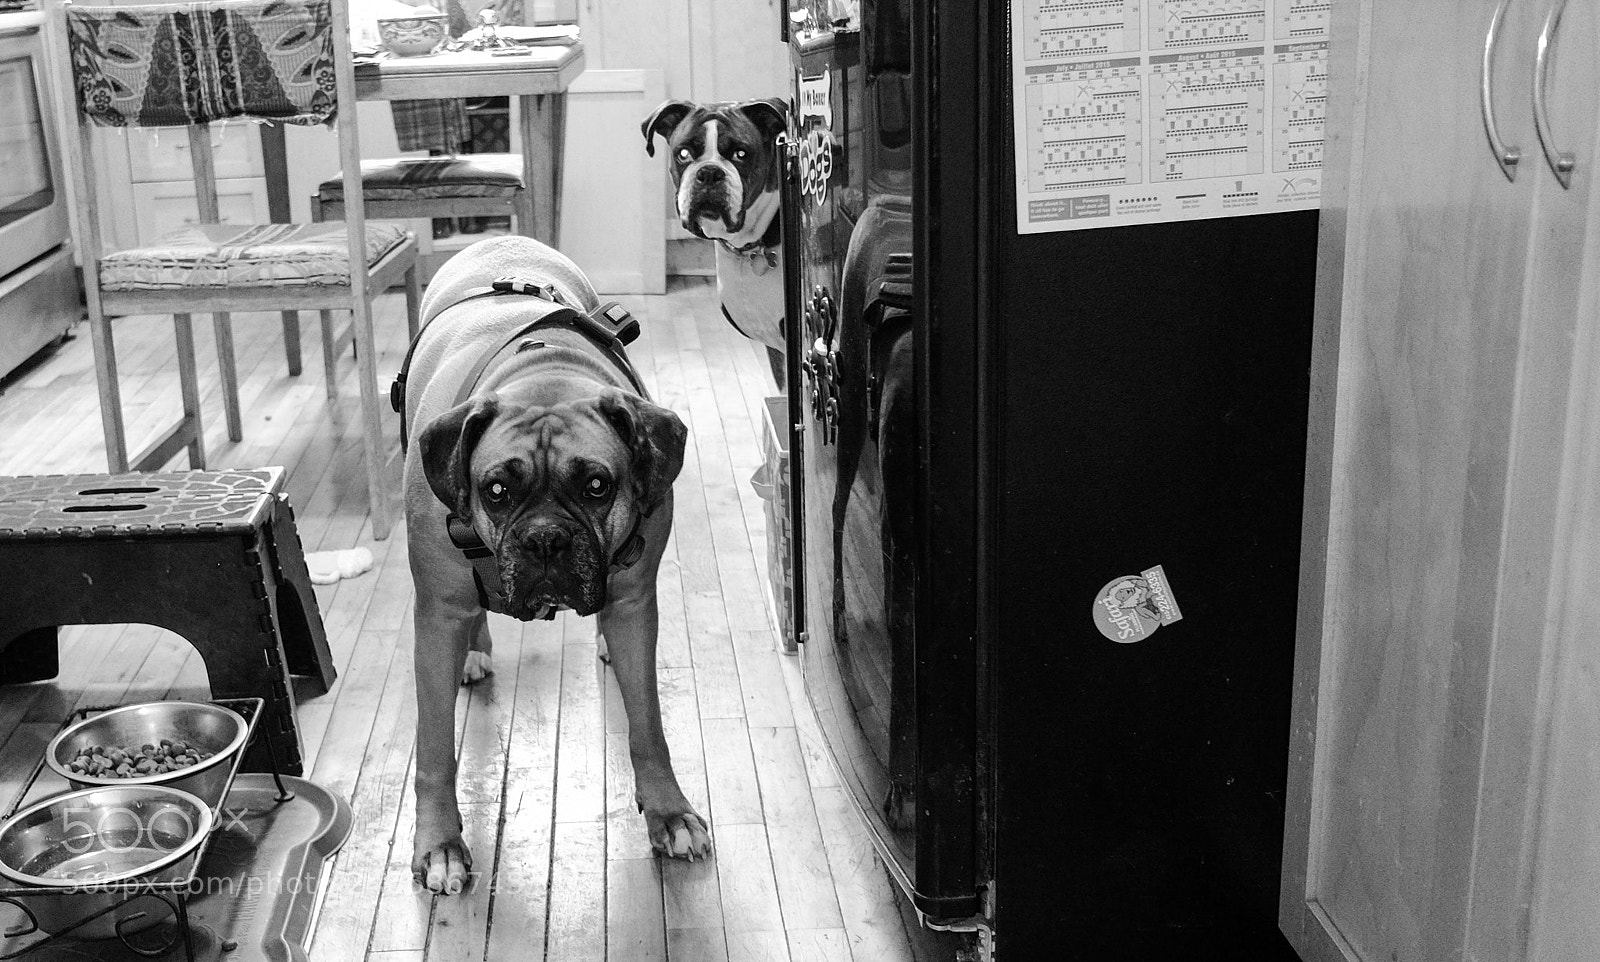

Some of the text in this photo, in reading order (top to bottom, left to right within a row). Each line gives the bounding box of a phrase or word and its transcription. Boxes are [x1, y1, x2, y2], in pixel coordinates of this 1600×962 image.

[1220, 50, 1236, 58] 2015
[1095, 61, 1110, 69] 2015
[1098, 596, 1135, 640] Safari
